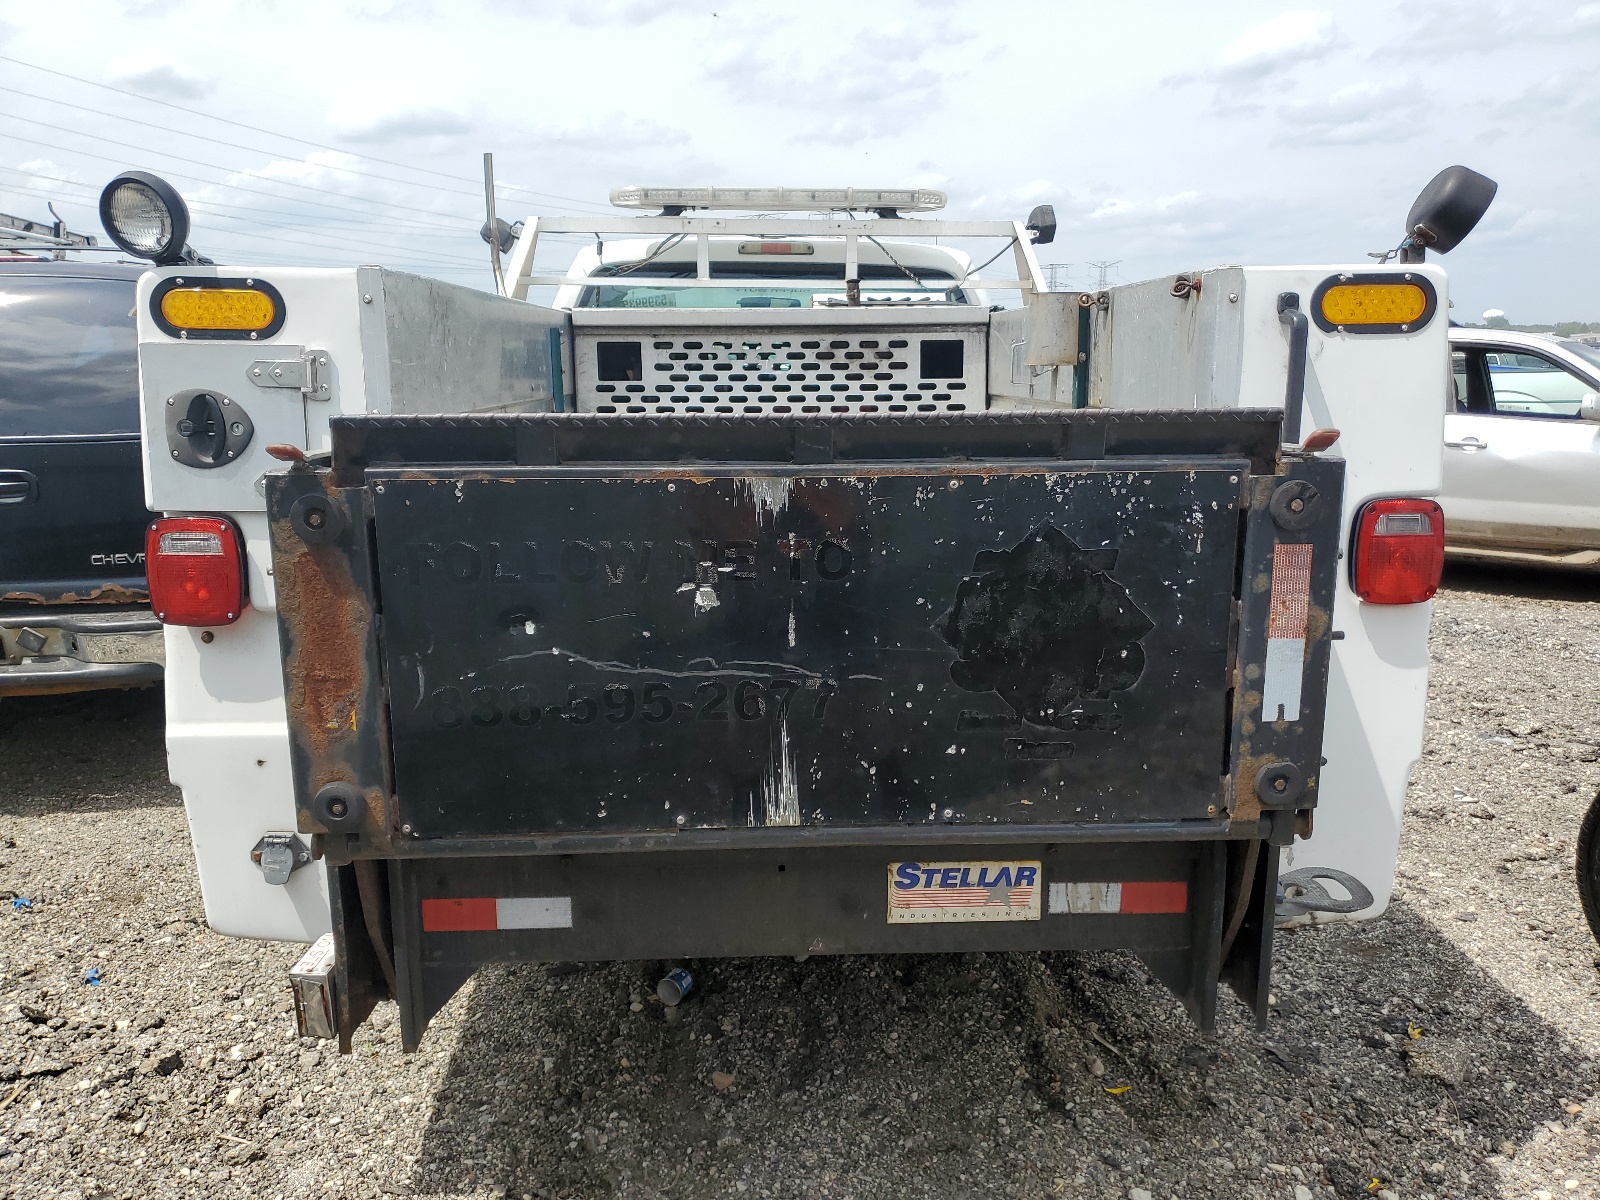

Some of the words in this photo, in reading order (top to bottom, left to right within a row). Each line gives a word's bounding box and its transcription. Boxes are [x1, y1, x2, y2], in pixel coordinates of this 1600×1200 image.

[406, 540, 654, 586] FOLLOW
[676, 539, 759, 583] ME
[777, 537, 852, 581] TO
[431, 678, 838, 729] 888-595-2677
[894, 863, 1038, 889] STELLAR
